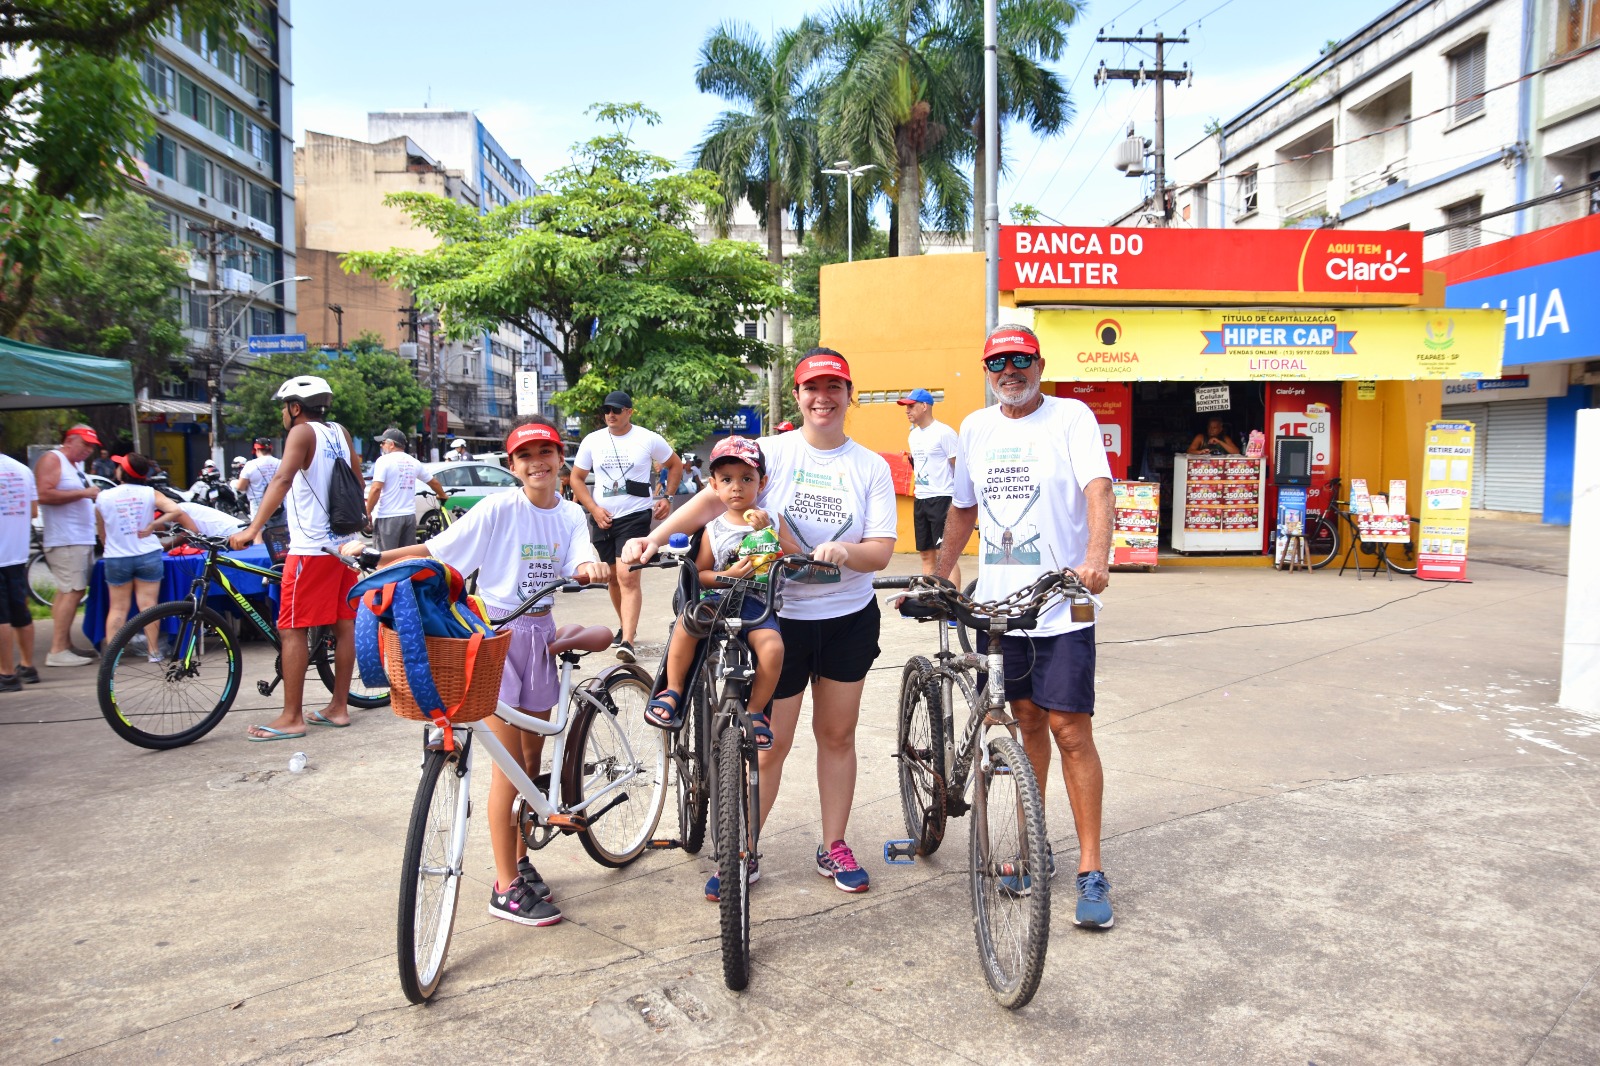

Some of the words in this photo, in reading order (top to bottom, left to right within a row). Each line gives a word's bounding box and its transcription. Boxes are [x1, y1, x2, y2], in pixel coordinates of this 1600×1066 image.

[1016, 232, 1103, 255] BANCA
[1110, 233, 1143, 256] DO
[1327, 243, 1355, 254] AQUI
[1357, 244, 1382, 255] TEM
[1014, 261, 1118, 285] WALTER
[1326, 256, 1400, 281] Claro
[1222, 315, 1253, 323] TÍTULO
[1268, 315, 1337, 324] CAPITALIZAÇÃO
[1224, 328, 1288, 345] HIPER
[1292, 328, 1335, 345] CAP
[1076, 352, 1140, 363] CAPEMISA
[1416, 353, 1446, 361] FEAPAES
[1249, 358, 1308, 370] LITORAL
[1084, 366, 1132, 374] CAPITALIZAÇÃO
[523, 377, 529, 388] E
[1279, 422, 1308, 437] 15
[1309, 422, 1325, 434] GB
[994, 466, 1030, 474] PASSEIO
[1000, 484, 1035, 492] VICENTE
[804, 493, 843, 504] PASSEIO
[808, 507, 847, 519] VICENTE
[816, 517, 843, 525] ANOS
